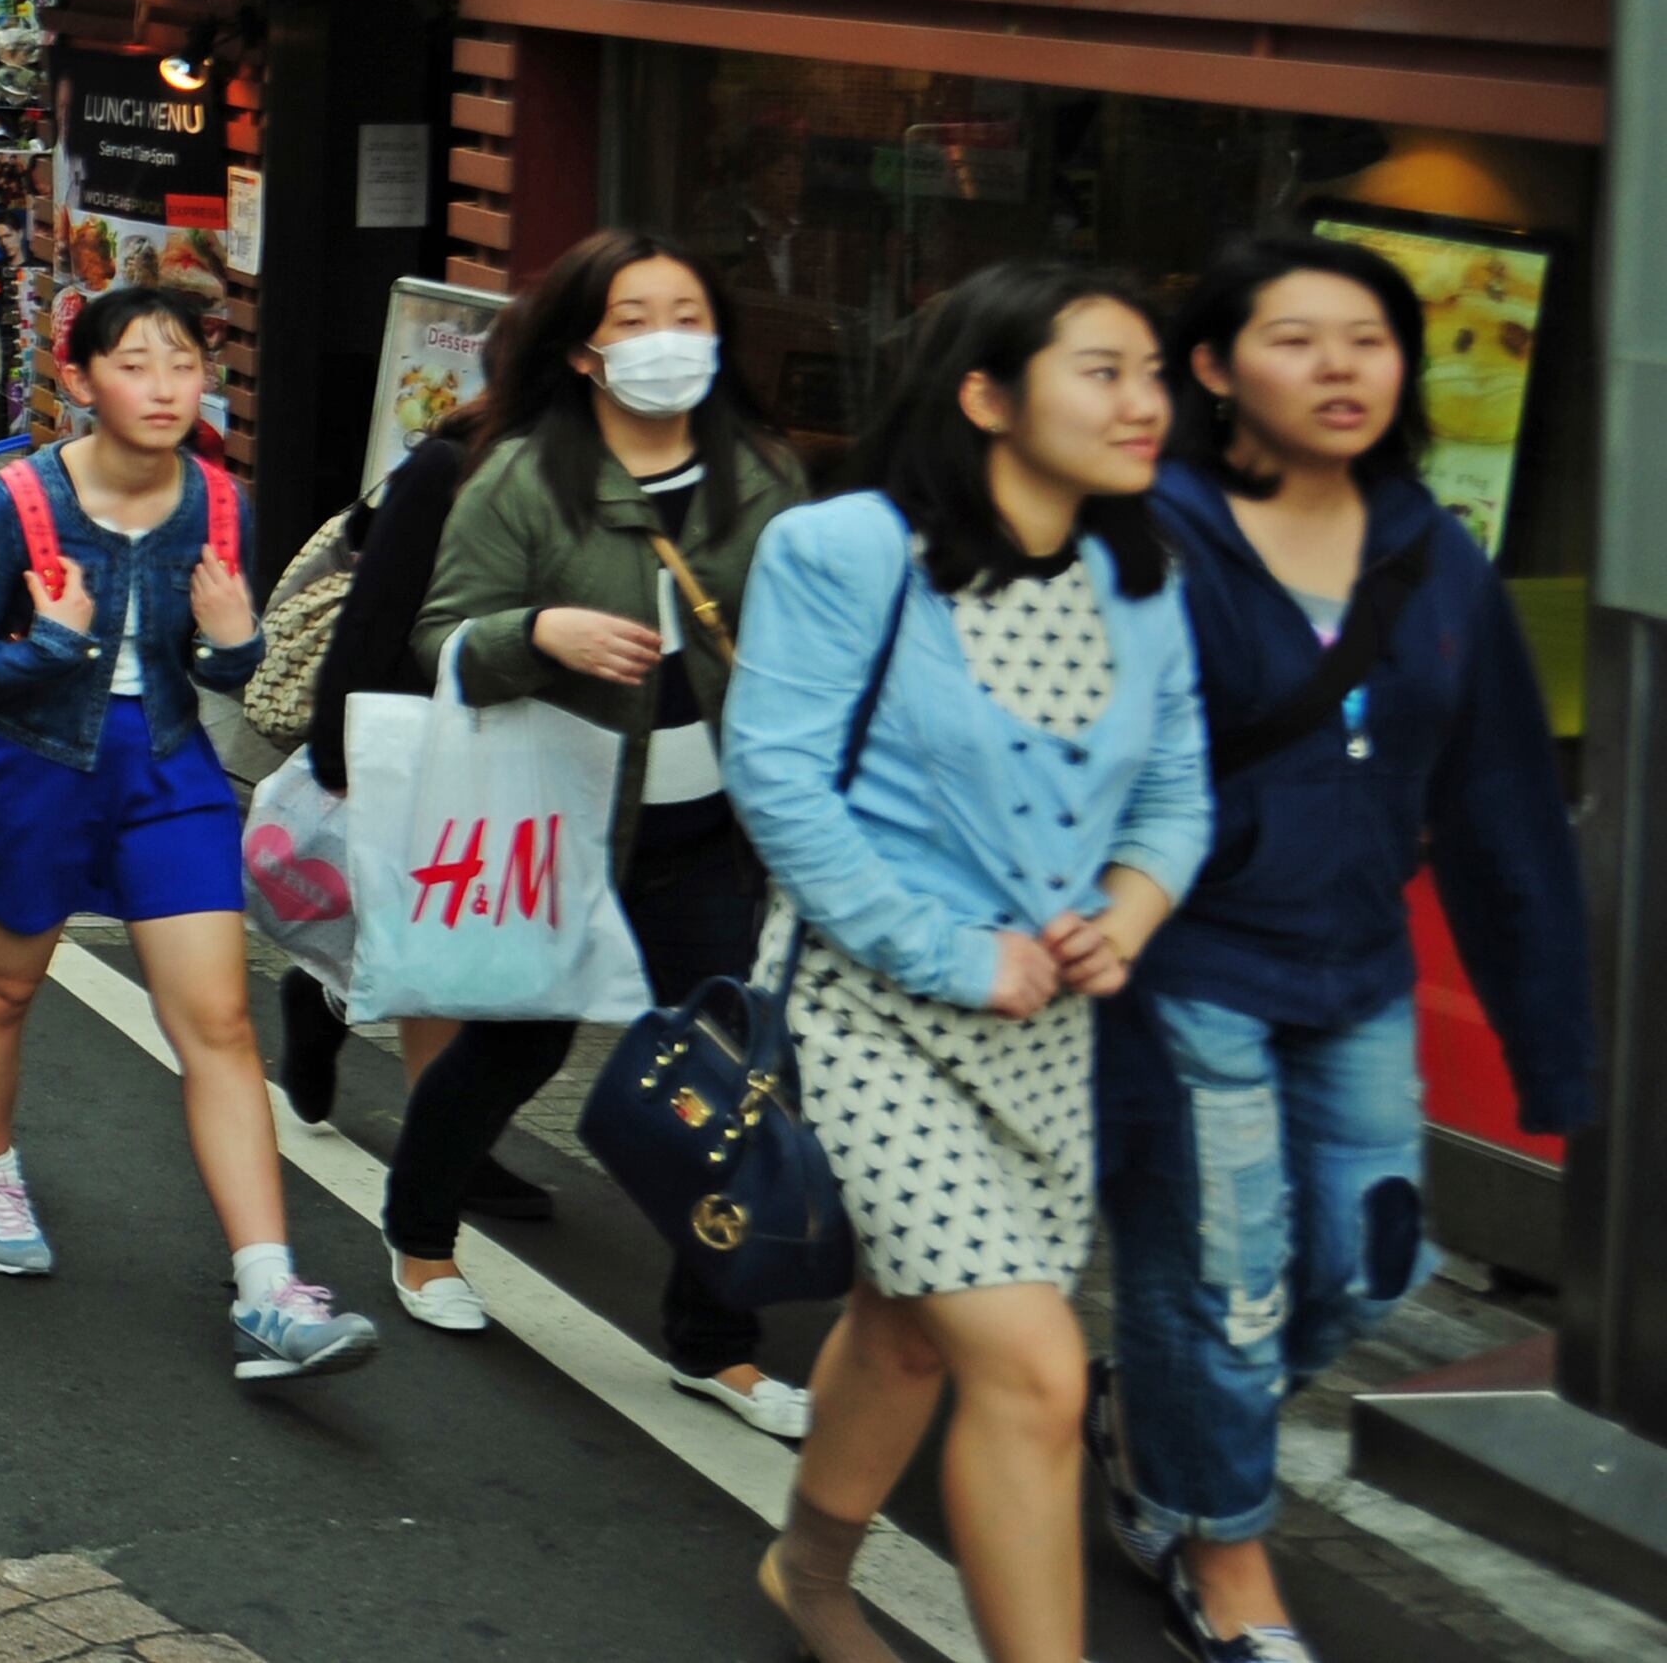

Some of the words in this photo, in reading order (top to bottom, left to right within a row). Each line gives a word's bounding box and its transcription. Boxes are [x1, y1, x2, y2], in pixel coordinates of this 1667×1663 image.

[83, 93, 144, 128] LUNCH
[147, 101, 205, 135] MENU
[98, 139, 134, 160] Served
[409, 811, 563, 931] H&M
